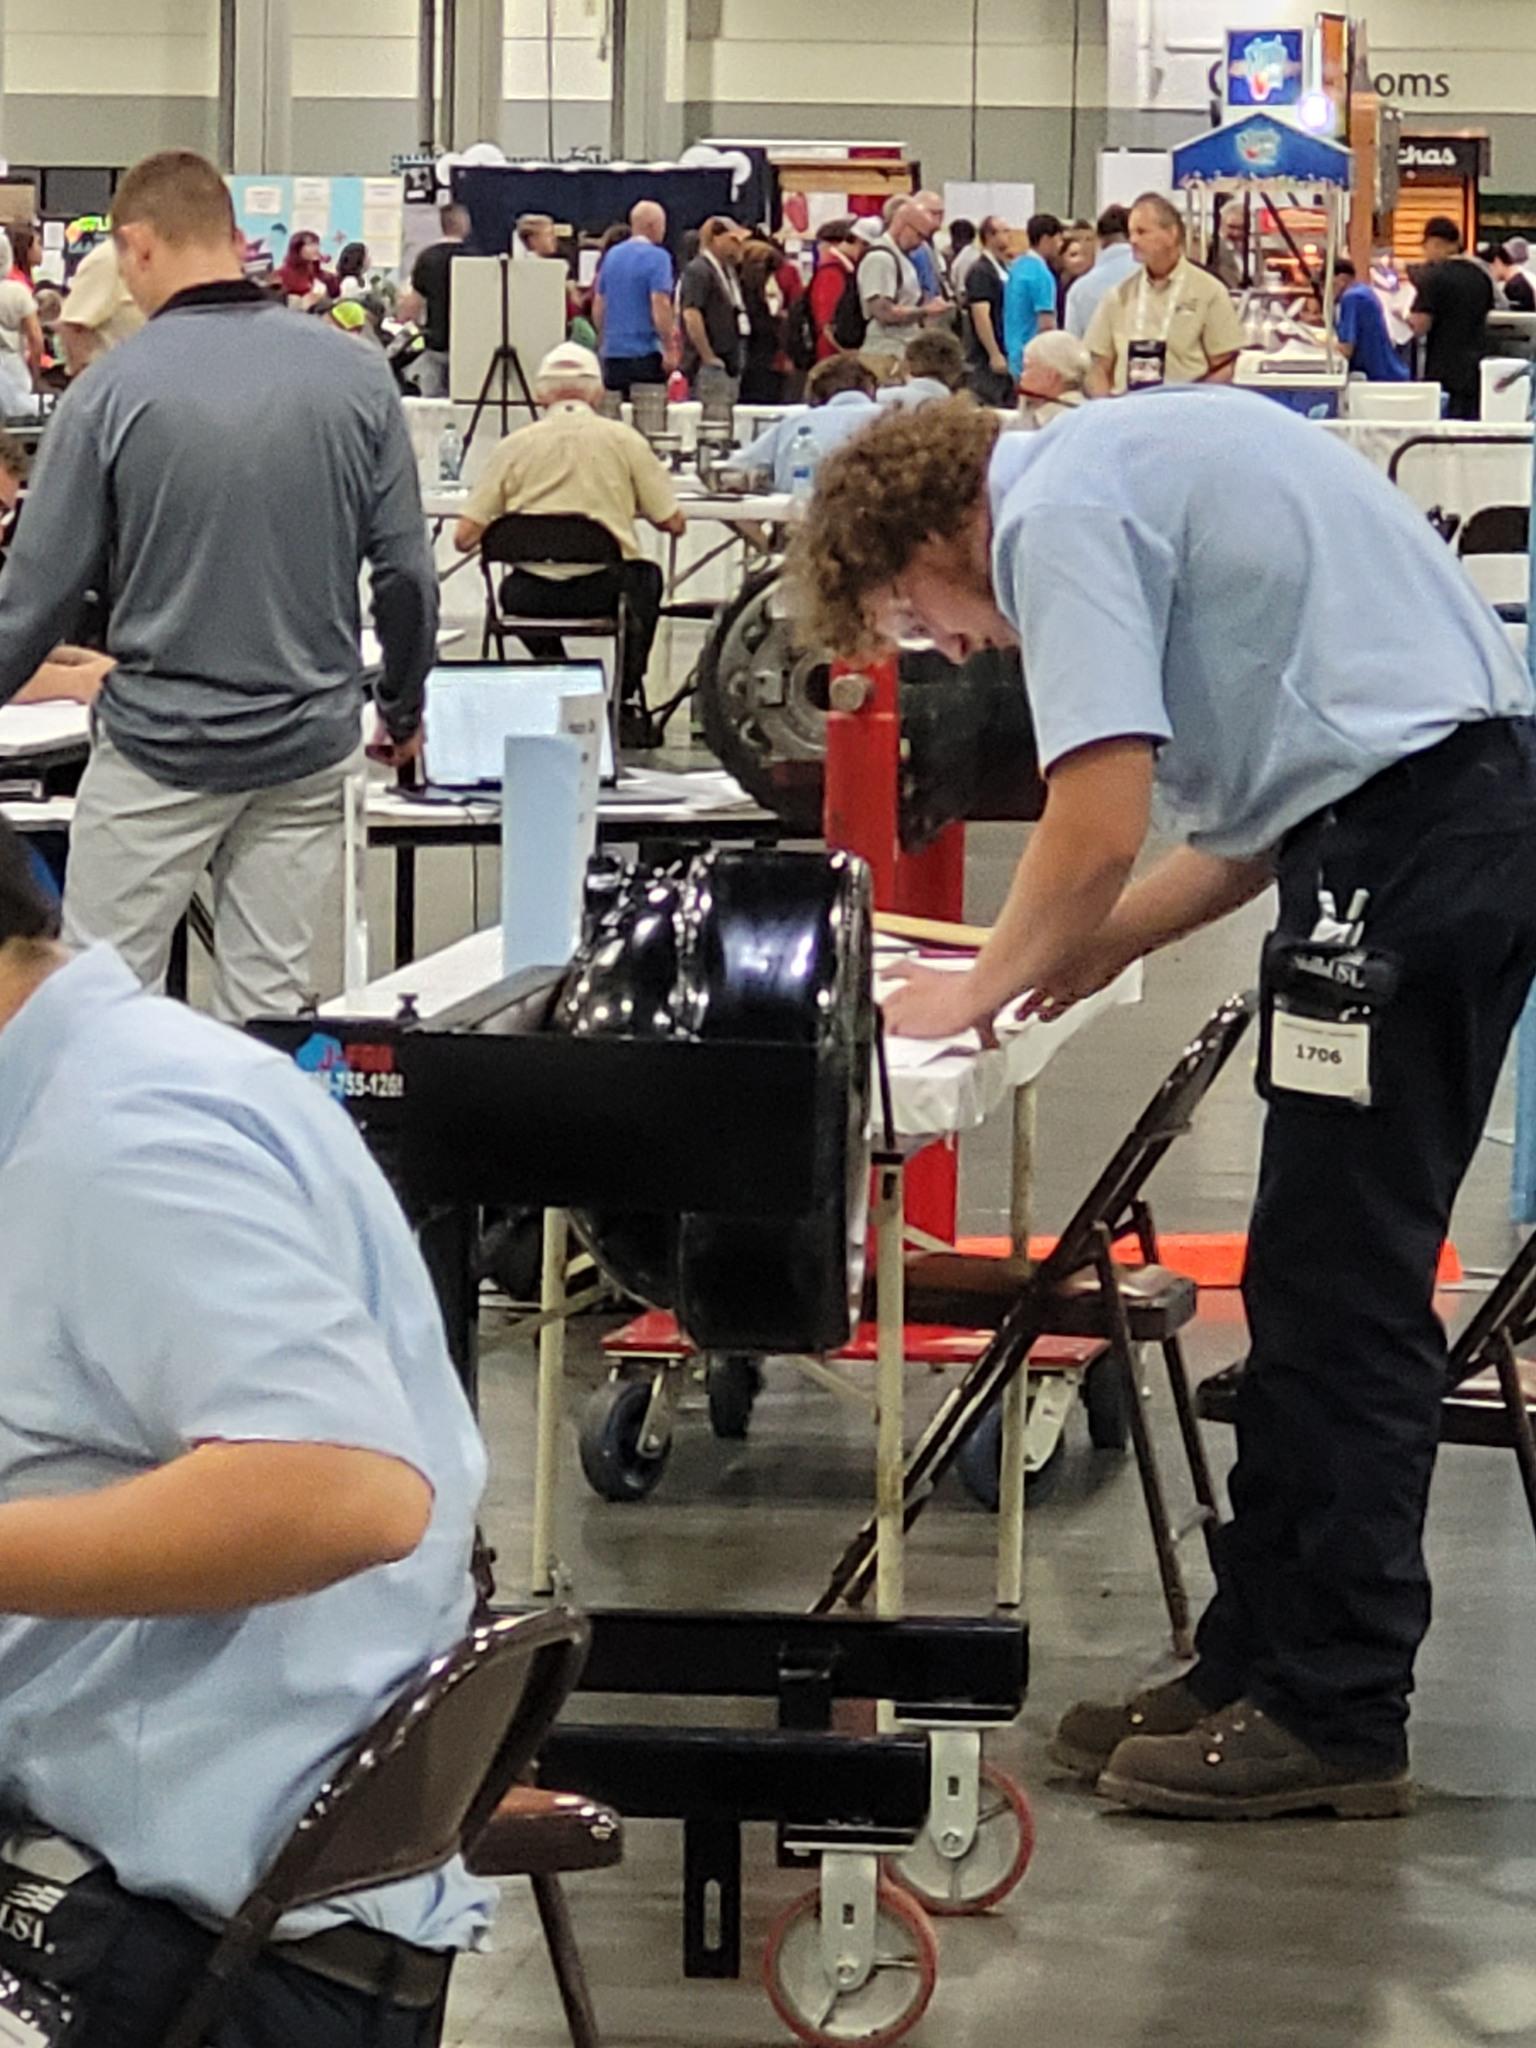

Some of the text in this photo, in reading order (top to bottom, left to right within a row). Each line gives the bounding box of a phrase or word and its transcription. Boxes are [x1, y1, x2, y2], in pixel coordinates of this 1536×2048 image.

[1374, 72, 1450, 97] oms
[1398, 144, 1457, 166] chas
[1296, 1043, 1343, 1065] 1706
